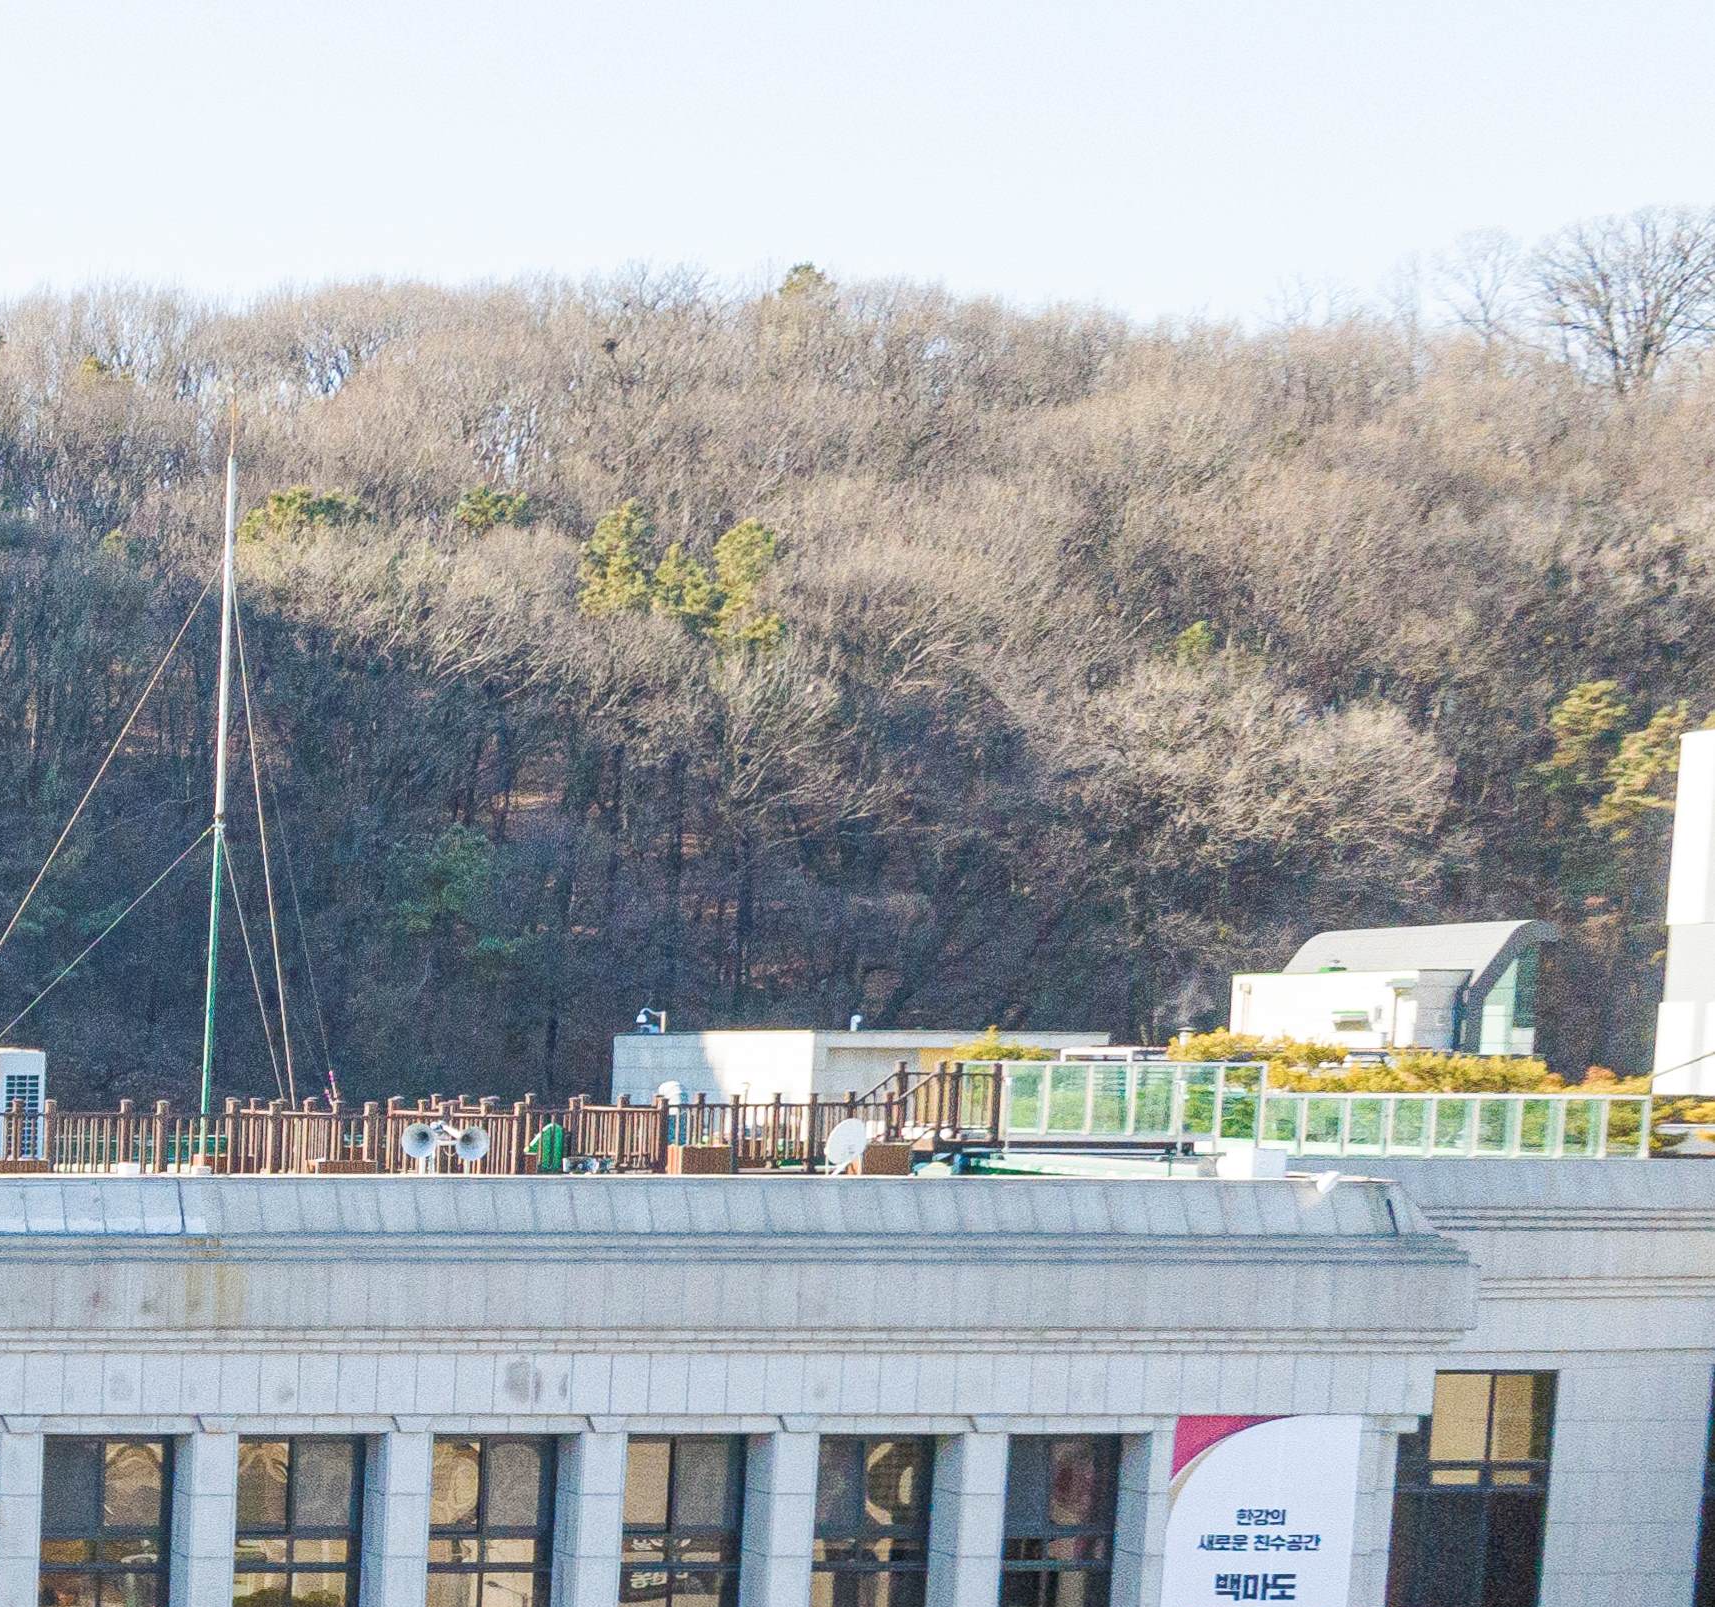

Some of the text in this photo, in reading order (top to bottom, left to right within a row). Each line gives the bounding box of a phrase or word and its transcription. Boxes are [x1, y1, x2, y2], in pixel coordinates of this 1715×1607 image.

[1236, 1508, 1286, 1526] 한강의
[1196, 1534, 1321, 1551] 새로운 친수공간
[1215, 1573, 1297, 1601] 백마도
